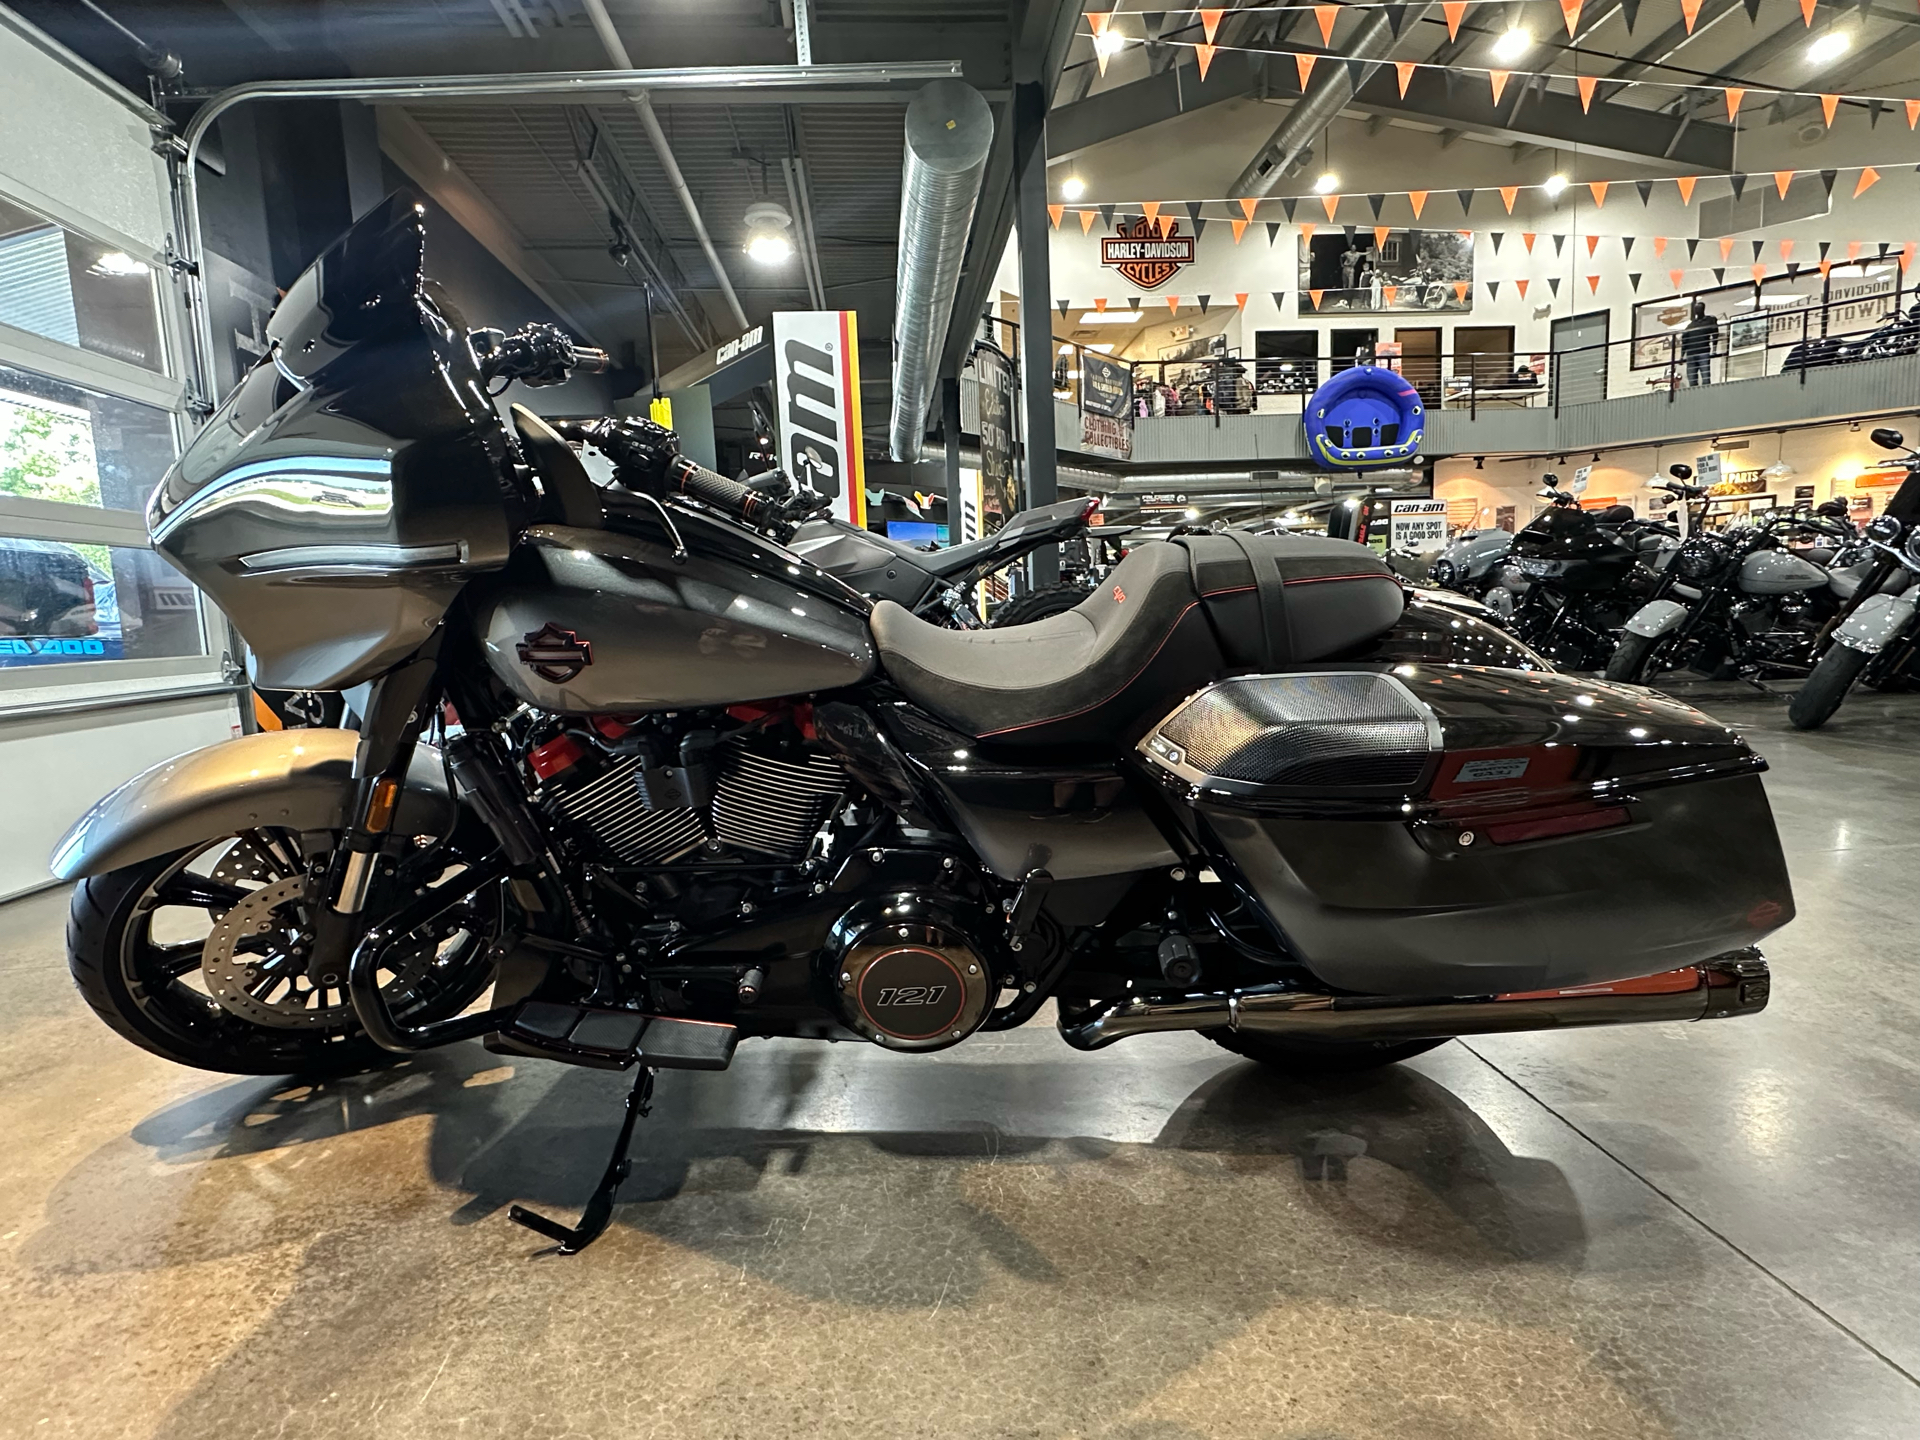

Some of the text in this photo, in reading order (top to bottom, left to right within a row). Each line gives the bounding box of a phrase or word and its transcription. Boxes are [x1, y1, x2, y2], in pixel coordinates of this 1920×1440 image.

[1107, 242, 1189, 259] HARLEY-DAVIDSON
[1126, 263, 1170, 283] CYCLES
[716, 325, 764, 365] can-am
[1728, 471, 1759, 484] PARTS
[1394, 503, 1445, 513] can-am
[1396, 522, 1410, 531] NOW
[1412, 521, 1425, 530] ANY
[1426, 521, 1442, 530] SPOT
[1396, 530, 1443, 540] IS A GOOD SPOT
[876, 985, 948, 1007] 121
